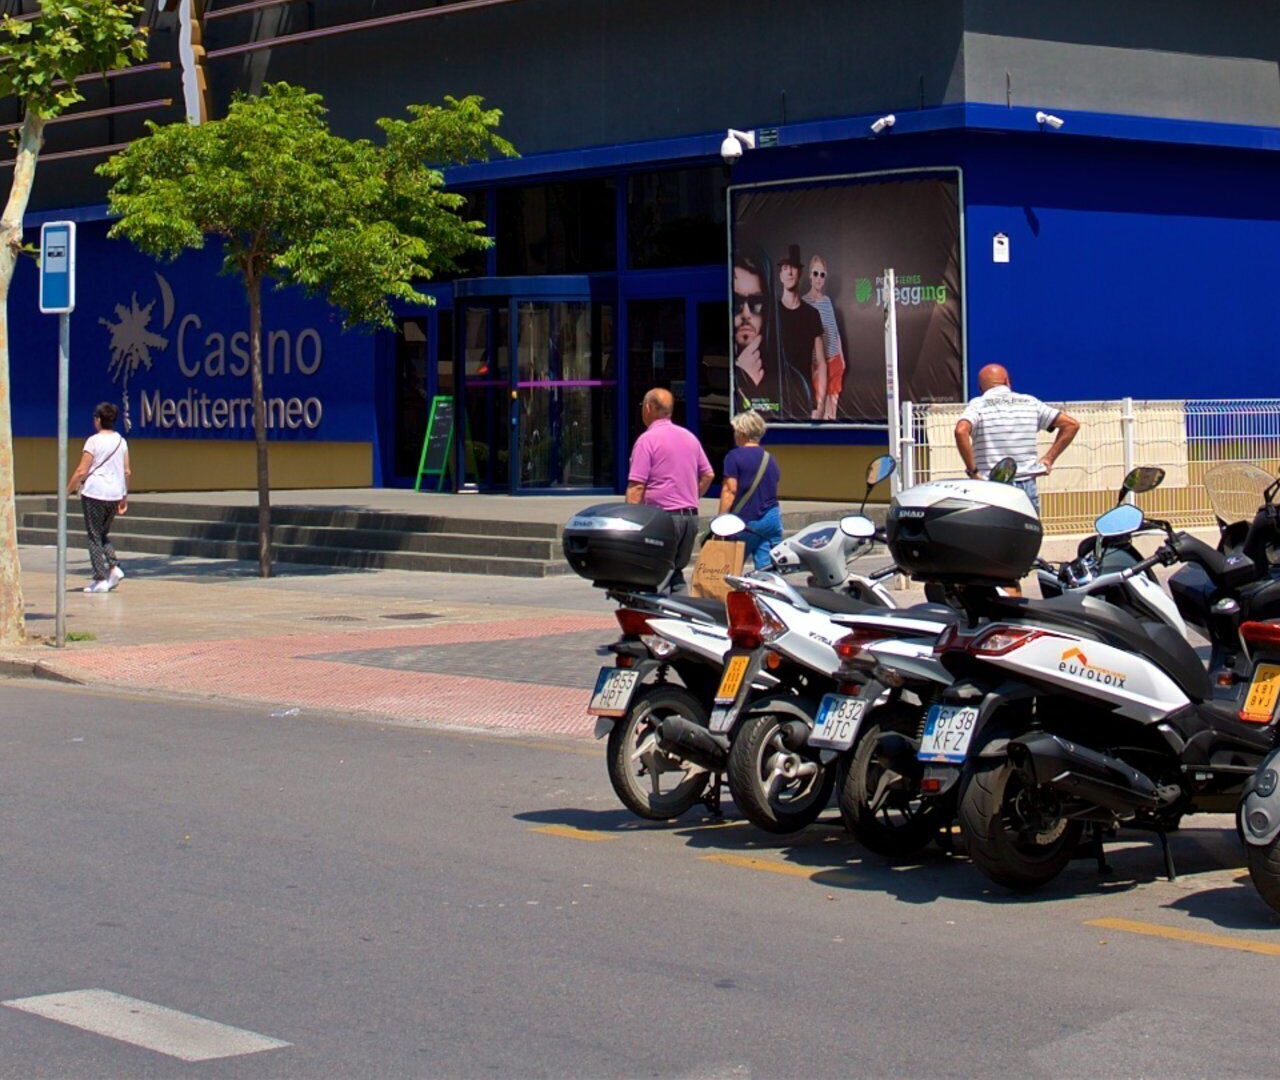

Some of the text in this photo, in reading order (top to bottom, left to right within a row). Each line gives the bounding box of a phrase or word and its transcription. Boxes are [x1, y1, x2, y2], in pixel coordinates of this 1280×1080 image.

[177, 313, 322, 378] Casno
[606, 671, 635, 690] 1855
[831, 698, 863, 721] 1832
[937, 708, 974, 731] 6138
[932, 731, 966, 751] KFZ
